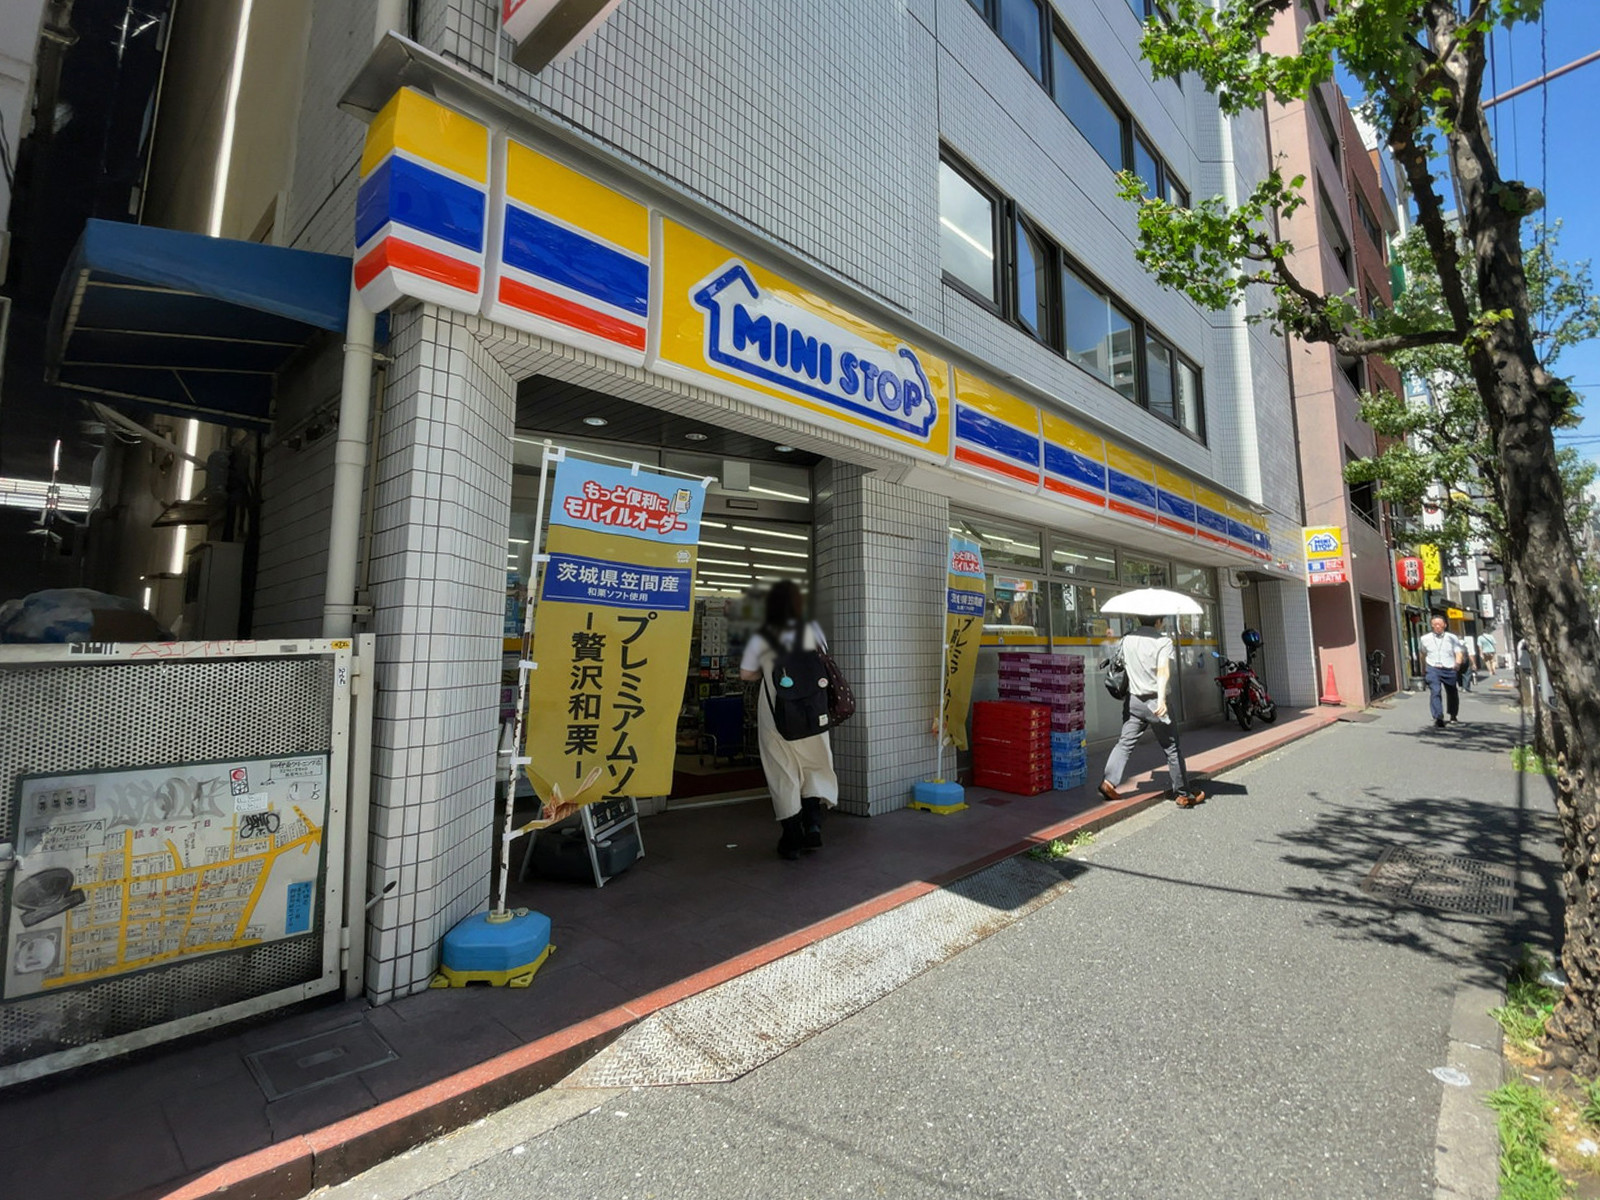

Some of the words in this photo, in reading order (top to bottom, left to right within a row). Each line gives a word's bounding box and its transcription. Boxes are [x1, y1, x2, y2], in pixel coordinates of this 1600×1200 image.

[733, 303, 832, 385] MINI
[838, 351, 923, 417] STOP
[584, 482, 669, 512] もっと便利に
[565, 498, 686, 533] モバイルオーダー
[557, 562, 680, 592] 茨城県笠間産
[601, 611, 658, 802] プレミアムソ
